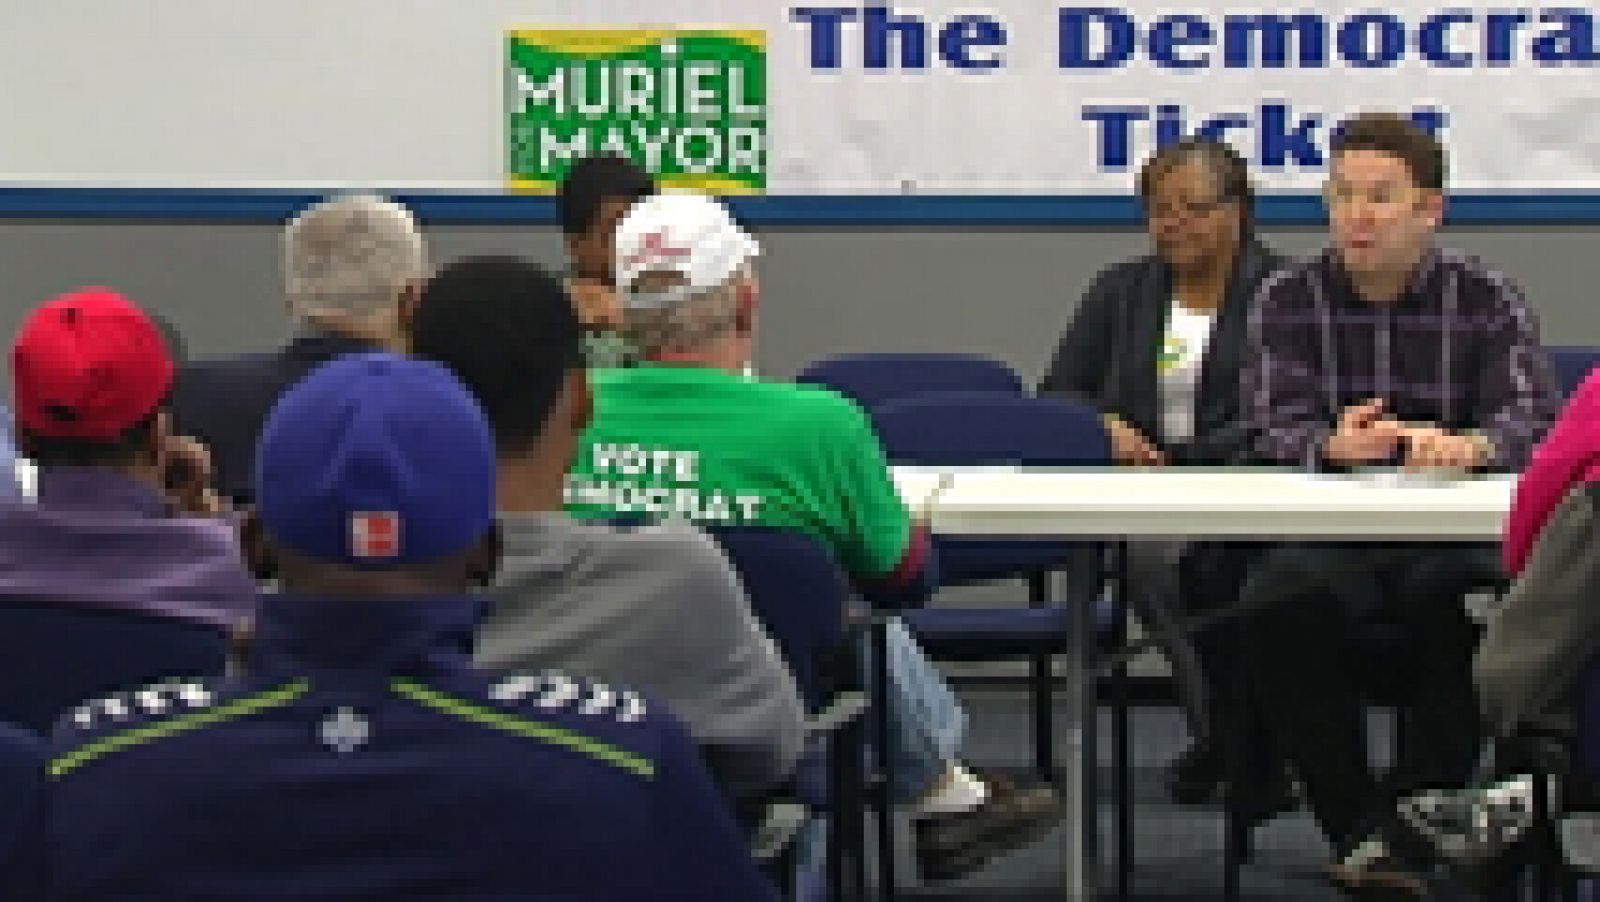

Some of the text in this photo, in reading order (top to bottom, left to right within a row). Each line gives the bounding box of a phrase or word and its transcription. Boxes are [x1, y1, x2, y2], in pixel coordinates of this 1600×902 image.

[792, 8, 1600, 70] The Democra
[510, 43, 765, 120] MURIEL
[540, 126, 766, 174] MAYOR
[1082, 100, 1449, 167] Tik
[592, 443, 700, 481] VOTE
